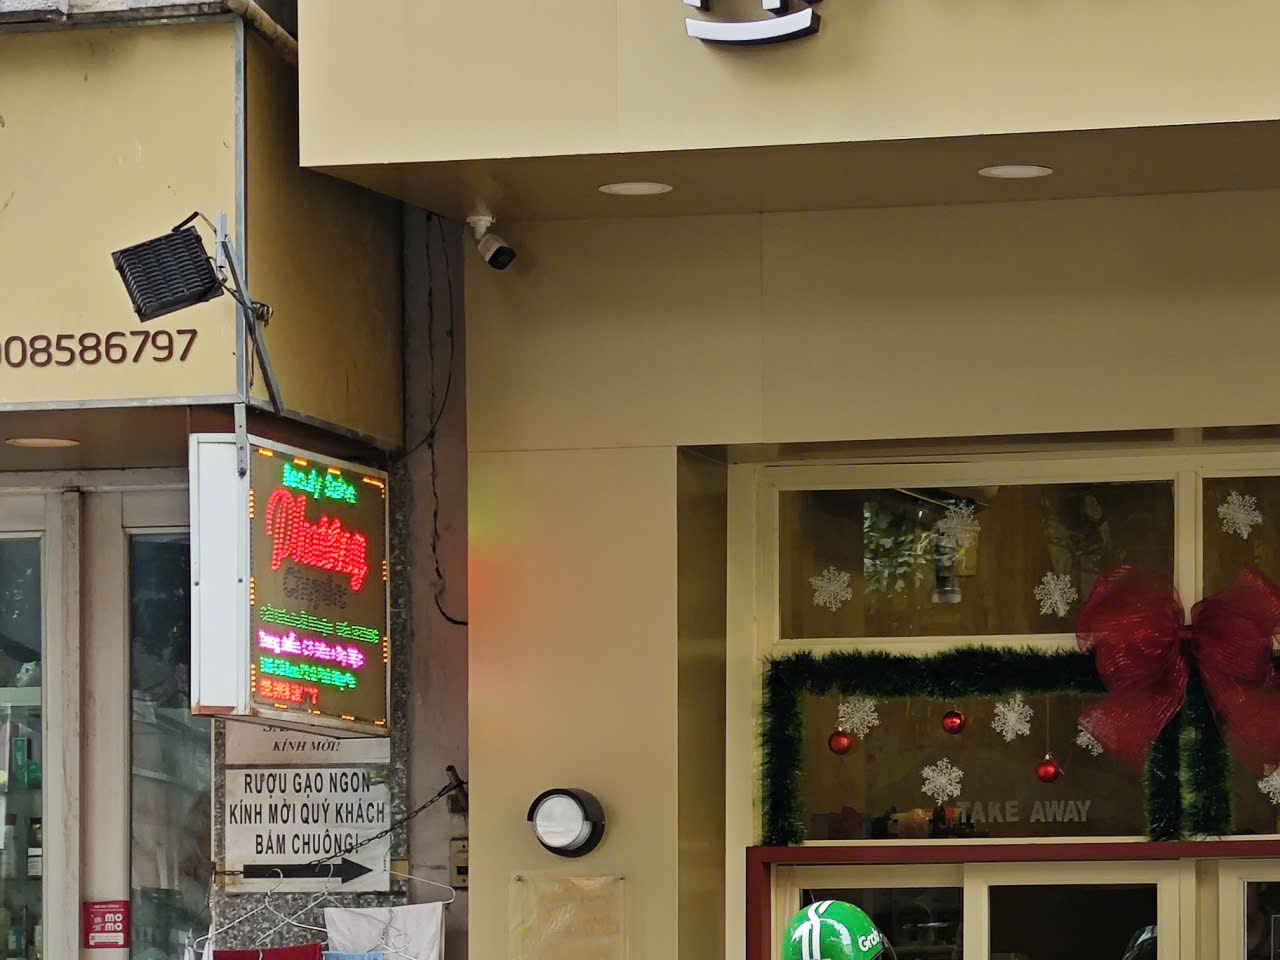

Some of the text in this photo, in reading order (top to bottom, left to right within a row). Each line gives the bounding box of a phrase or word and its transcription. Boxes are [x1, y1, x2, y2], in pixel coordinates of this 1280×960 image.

[0, 329, 198, 368] 08586797
[244, 771, 371, 799] RƯỢU GẠO NGON
[229, 798, 385, 825] KÍNH MỜI QUÝ KHÁCH
[956, 799, 1092, 823] TAKE AWAY
